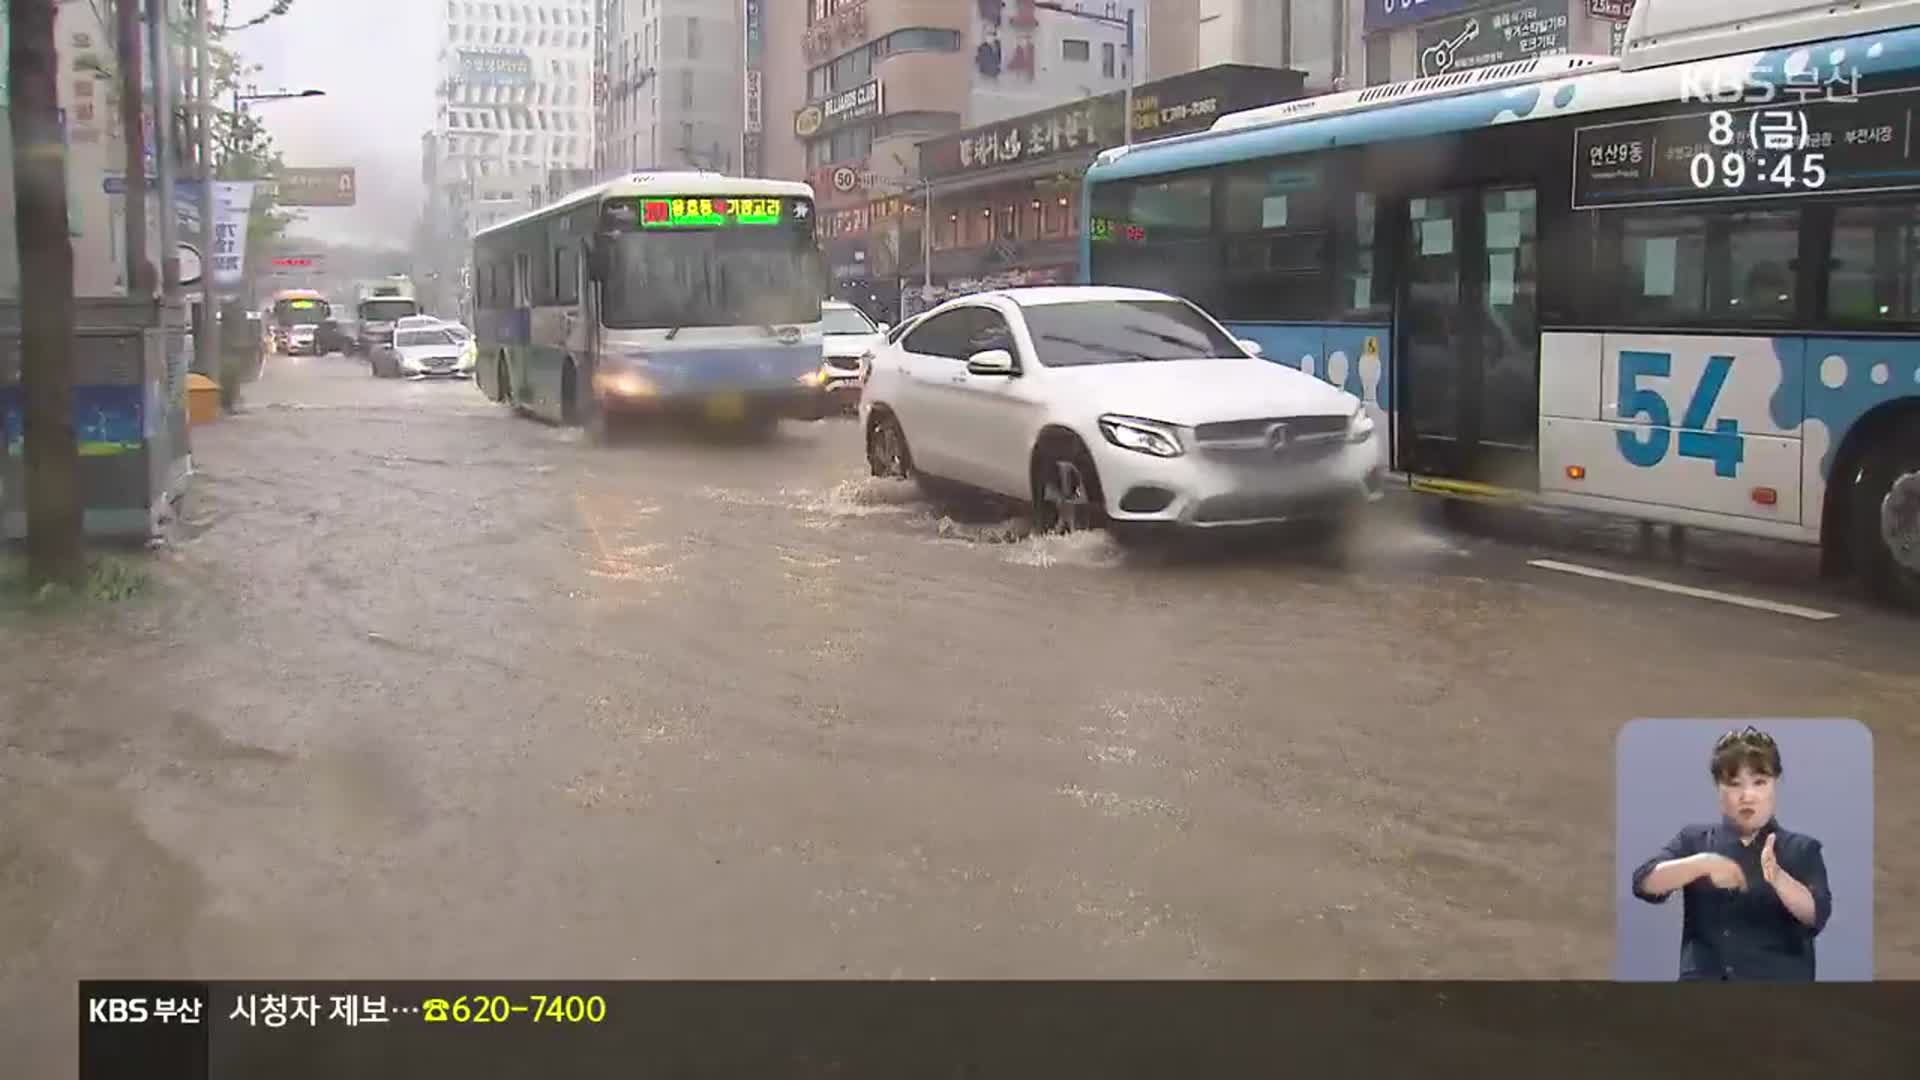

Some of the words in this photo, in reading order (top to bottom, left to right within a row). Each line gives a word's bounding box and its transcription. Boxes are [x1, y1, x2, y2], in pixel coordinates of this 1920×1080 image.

[858, 82, 877, 106] CLUB
[1844, 126, 1893, 144] 부전시장
[1590, 141, 1643, 167] 연산9동
[838, 173, 852, 186] 50
[1616, 350, 1744, 479] 54
